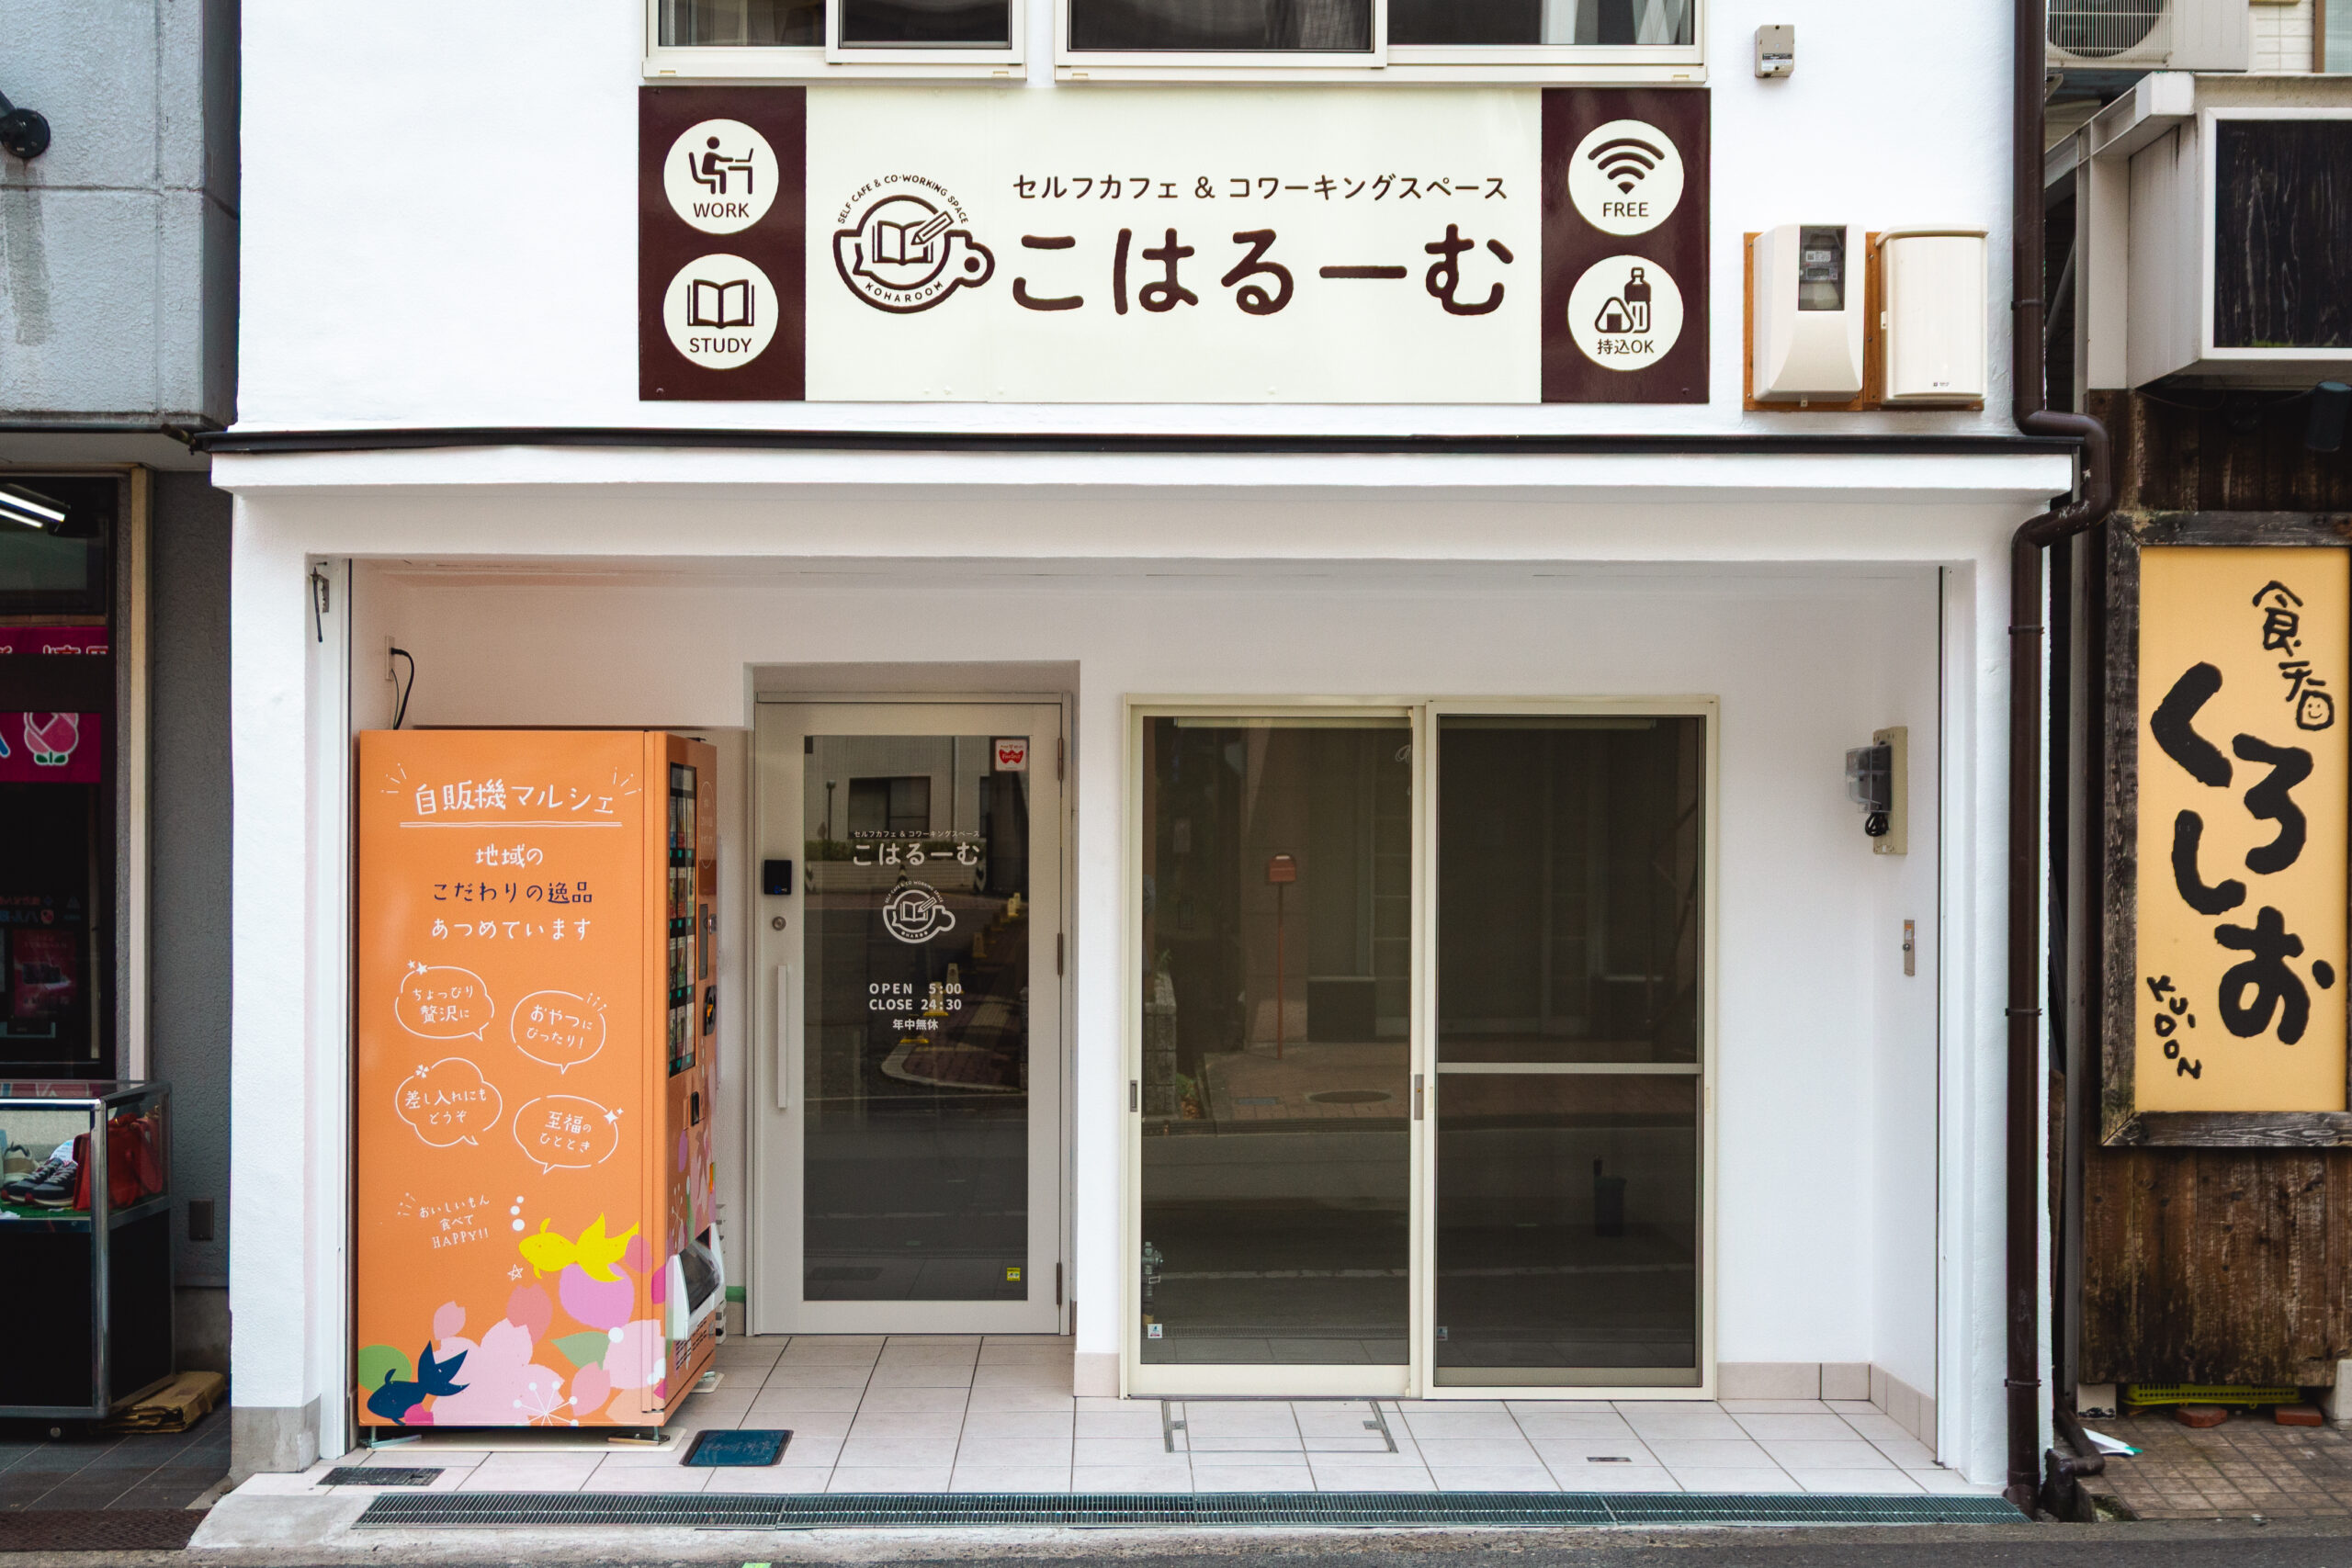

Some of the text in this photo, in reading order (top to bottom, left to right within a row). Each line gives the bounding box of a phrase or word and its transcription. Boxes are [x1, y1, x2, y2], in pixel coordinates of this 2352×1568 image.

[1012, 174, 1509, 201] セルフカフェ & コワーキングスペース
[693, 202, 751, 219] WORK
[837, 202, 854, 224] SELF
[851, 183, 873, 203] CAFE
[874, 179, 882, 187] &
[947, 196, 969, 224] SPACE
[1602, 202, 1649, 218] FREE
[1012, 223, 1514, 316] こはるーむ
[865, 281, 944, 303] KOHAROOM
[689, 337, 752, 354] STUDY
[1597, 338, 1655, 355] 持込OK
[415, 779, 614, 816] 自販機マルシェ
[854, 829, 897, 838] セルフカフェ
[475, 843, 544, 868] 地域の
[854, 841, 980, 865] こはるーむ
[433, 881, 593, 904] こだわりの逸品
[432, 919, 591, 941] あつめています
[413, 986, 474, 1001] ちょっぴり
[869, 983, 962, 994] OPEN 5:00
[420, 1005, 469, 1024] 贅沢に
[869, 999, 962, 1010] CLOSE 24:30
[530, 1004, 593, 1030] おやつに
[892, 1019, 939, 1031] 年中無休
[405, 1089, 487, 1109] 差し入れにも
[429, 1110, 467, 1125] どうぞ
[545, 1111, 592, 1134] 至福の
[539, 1132, 591, 1153] ひととき
[419, 1194, 490, 1218] おいしいもん
[440, 1213, 474, 1232] 食べて
[432, 1227, 489, 1249] HAPPY!!
